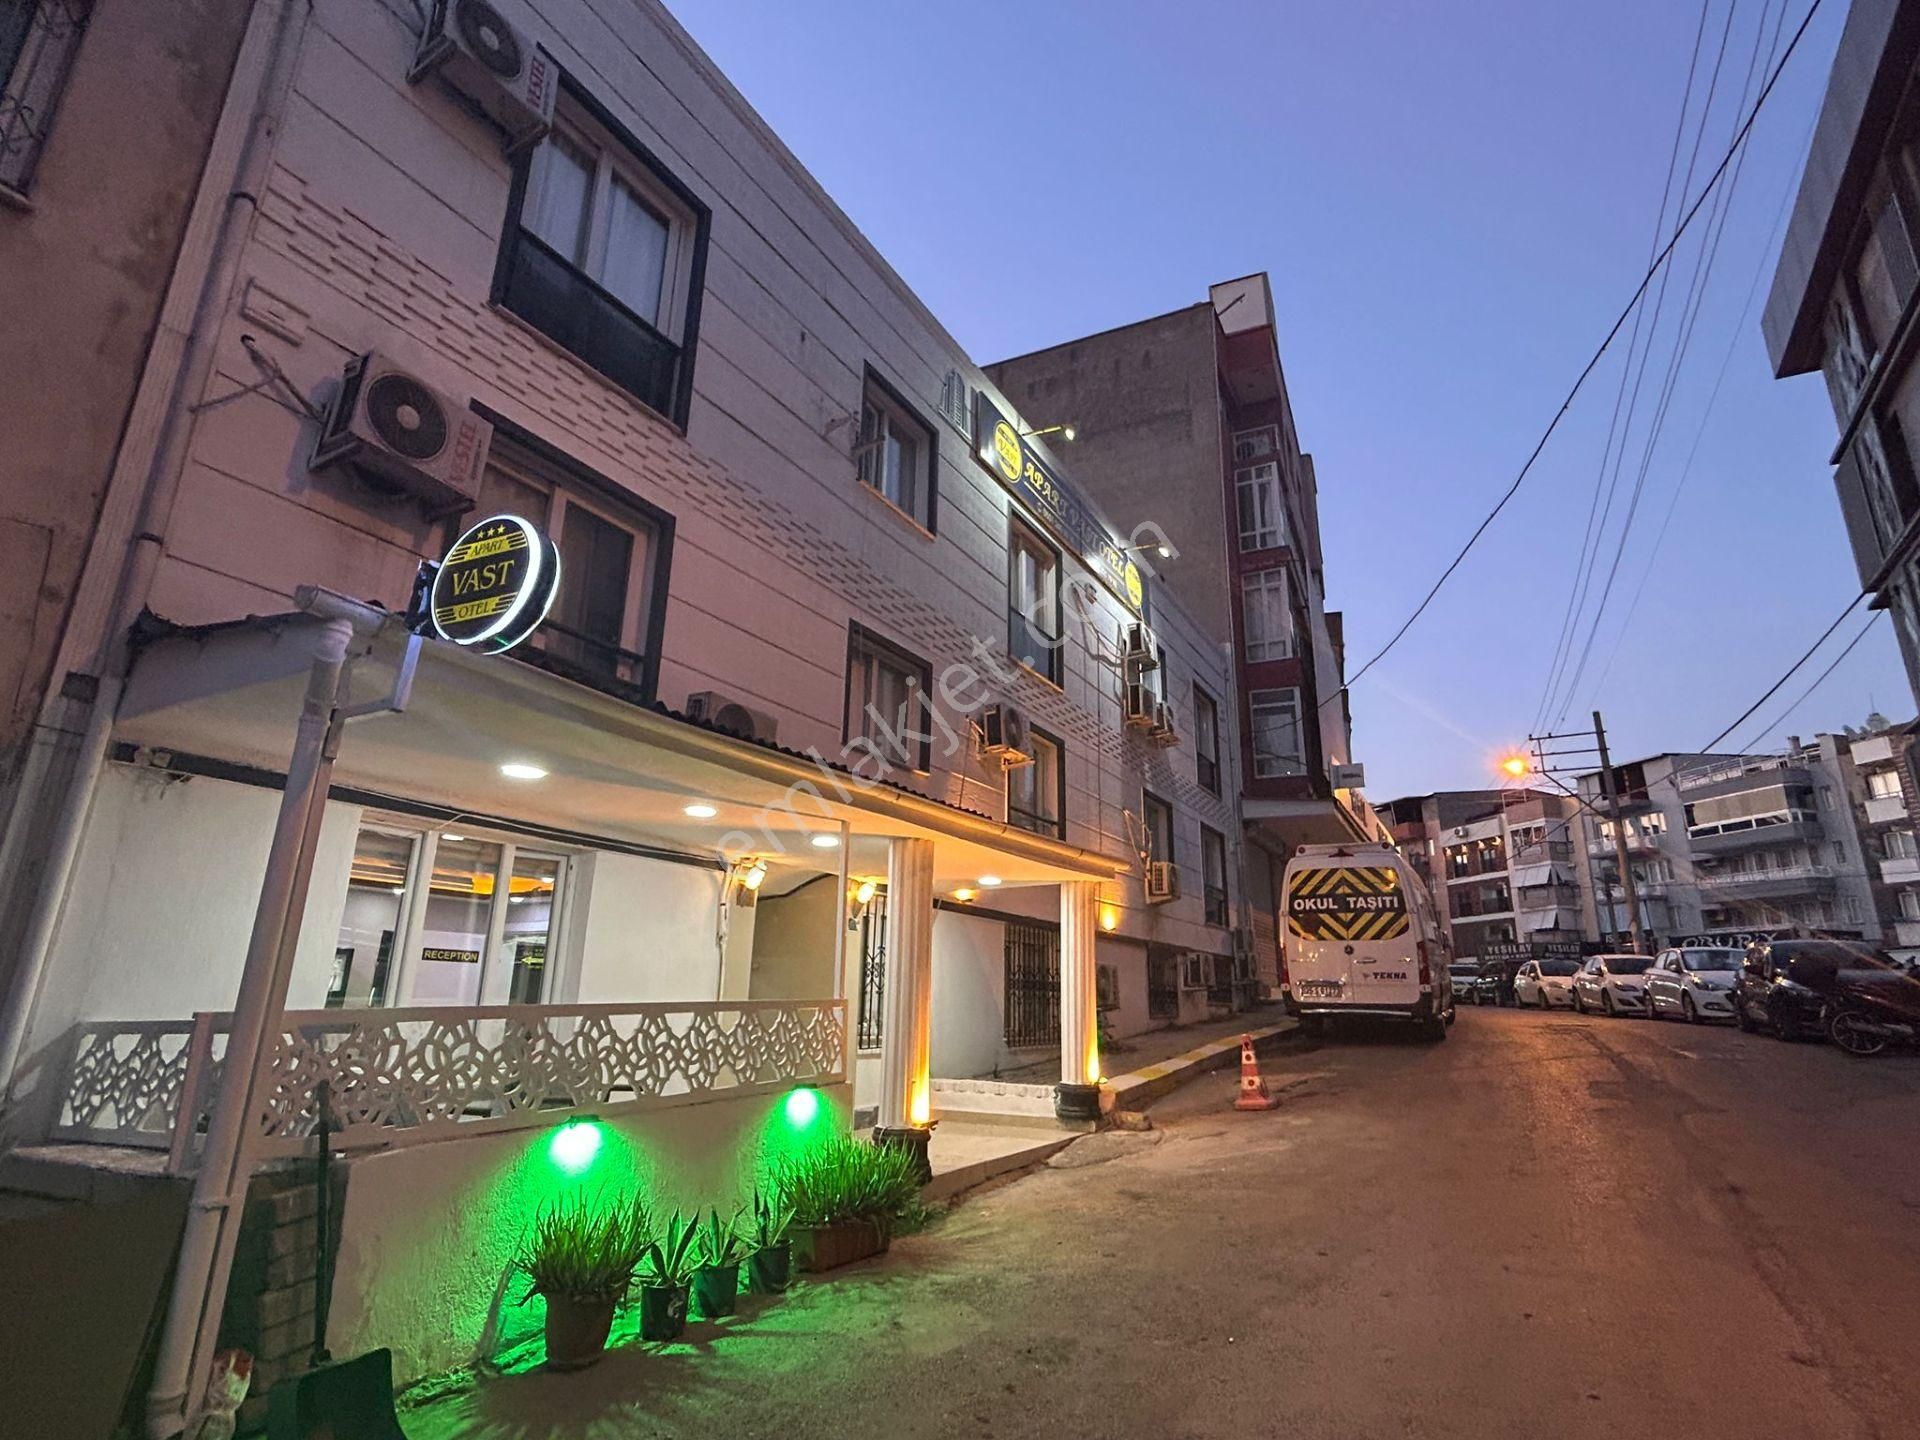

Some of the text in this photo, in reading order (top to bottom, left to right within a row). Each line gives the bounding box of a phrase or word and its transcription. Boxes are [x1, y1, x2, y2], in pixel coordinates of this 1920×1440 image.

[1024, 462, 1068, 517] APART
[1100, 541, 1126, 579] OTEL
[471, 540, 504, 556] APART
[452, 560, 515, 596] VAST
[458, 602, 490, 619] OTEL
[1293, 896, 1399, 911] OKUL TAŞITI
[424, 950, 478, 961] RECEPTION
